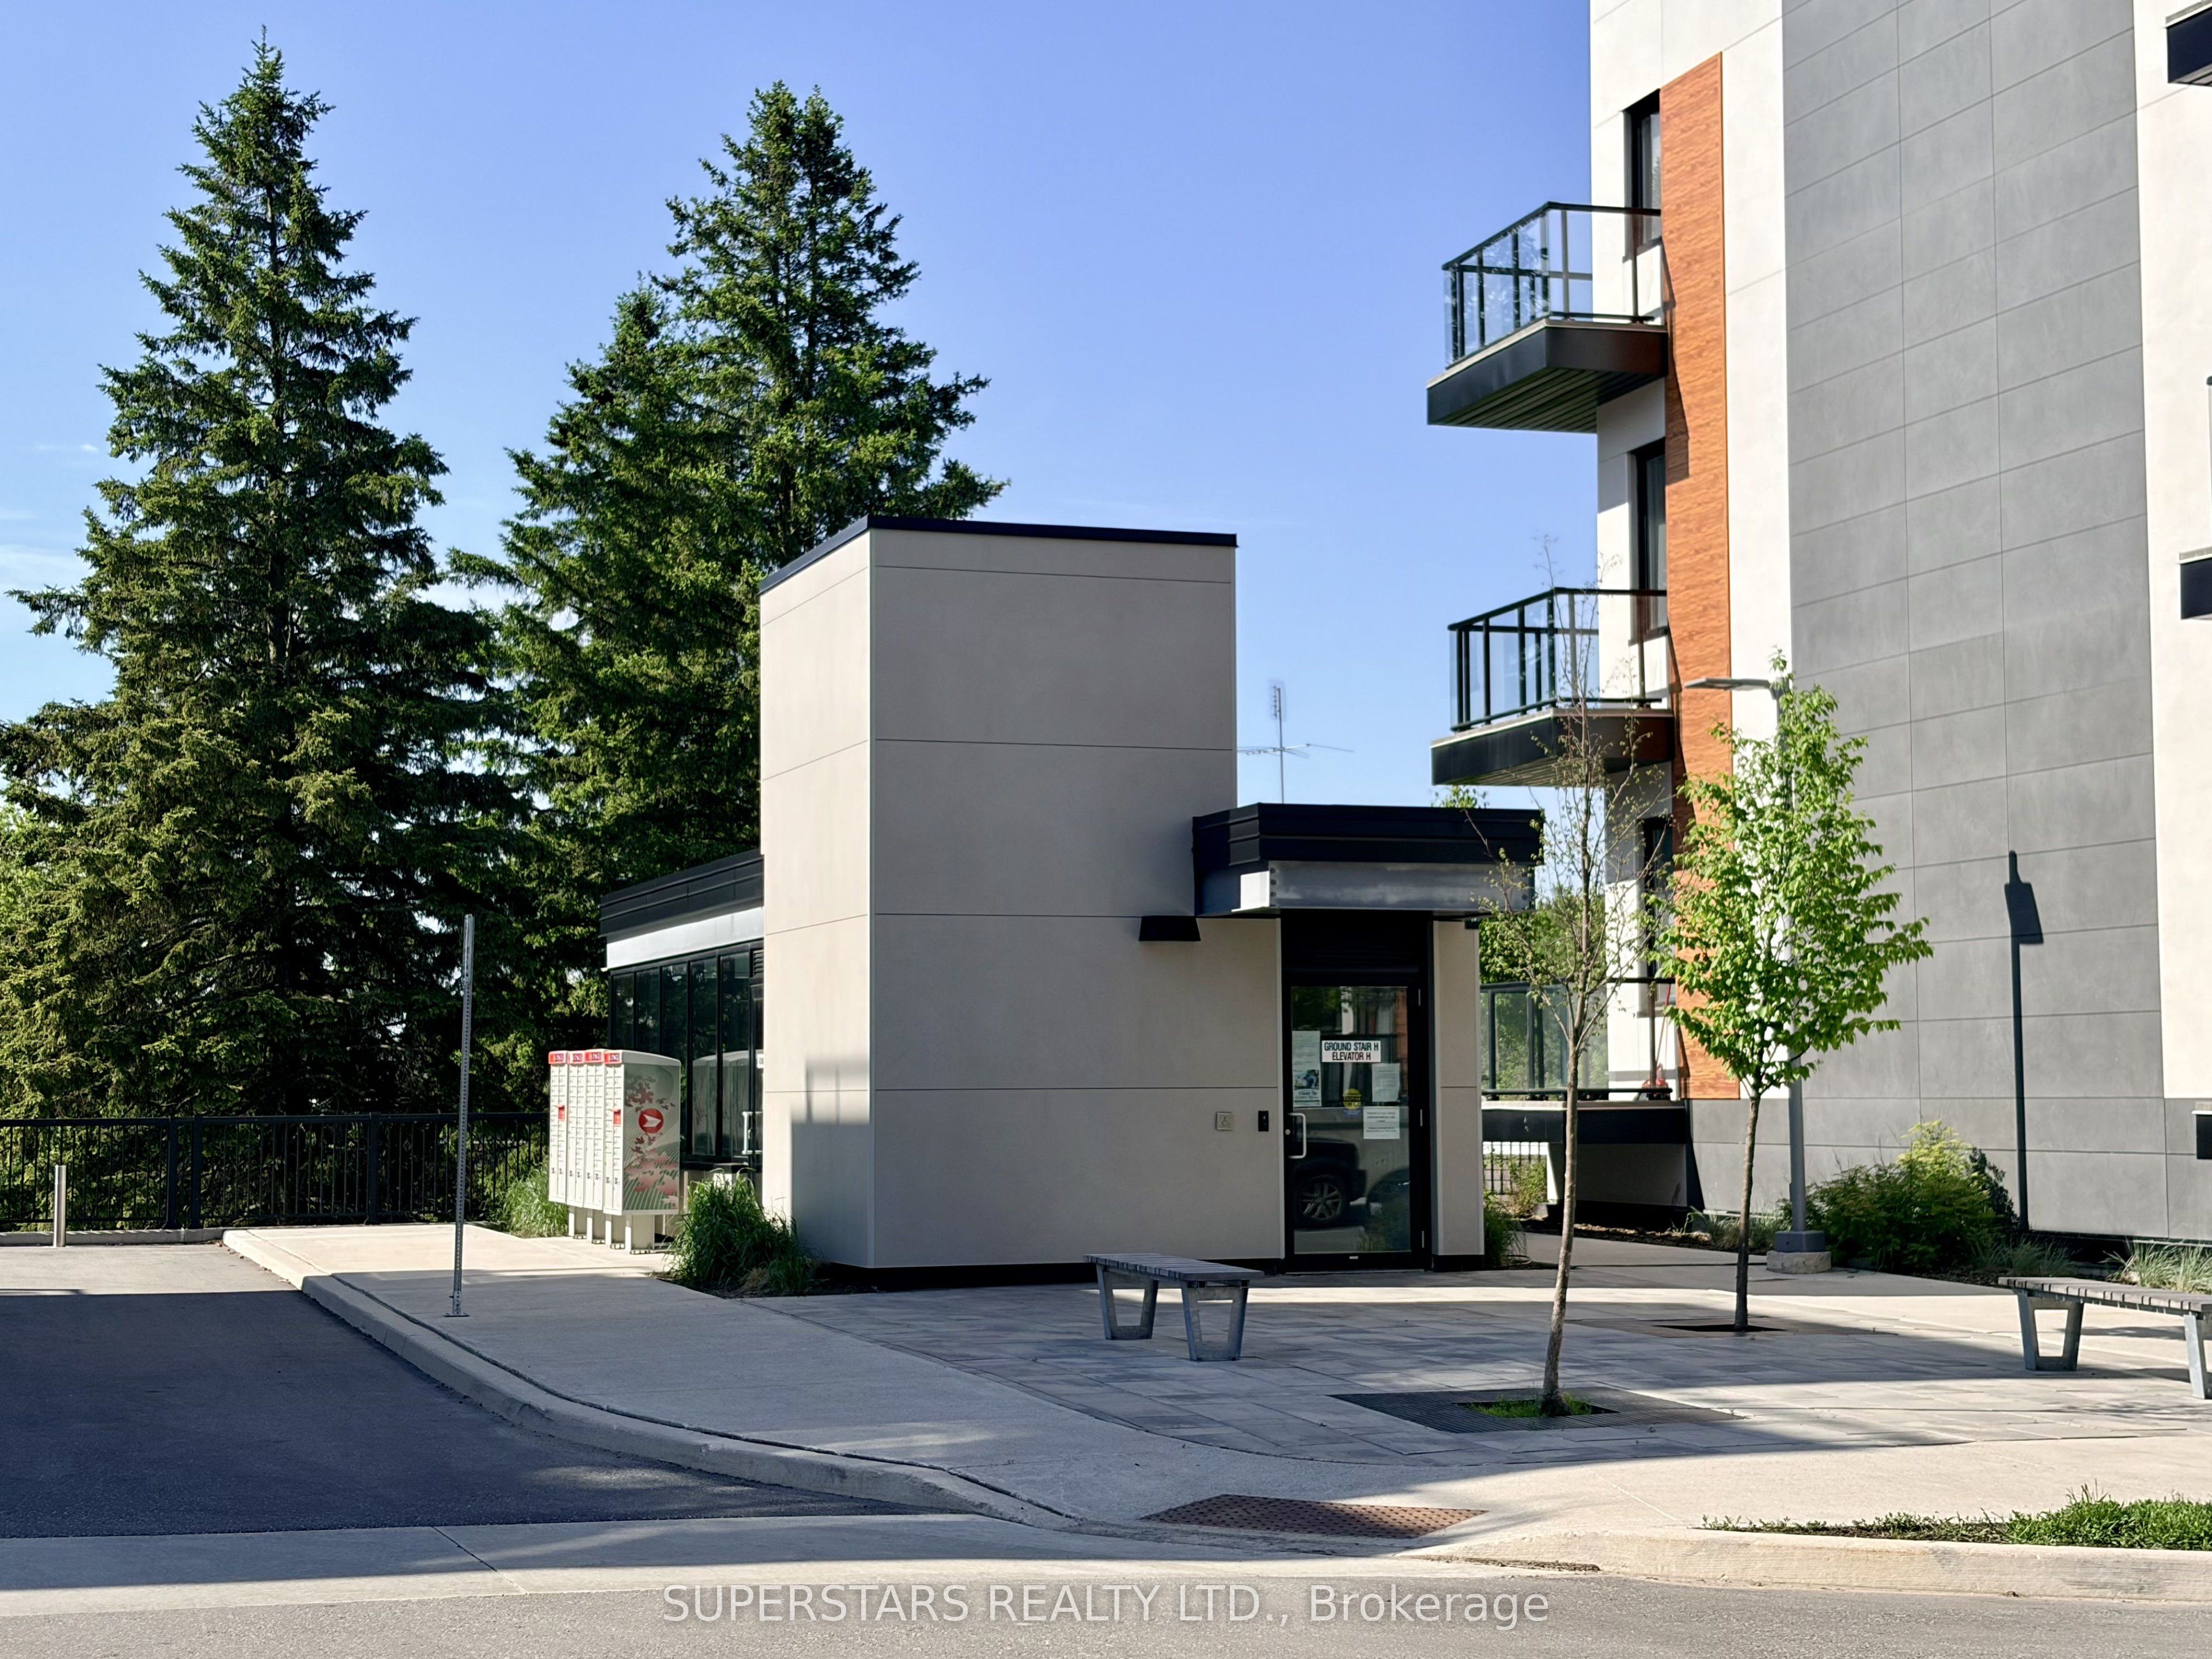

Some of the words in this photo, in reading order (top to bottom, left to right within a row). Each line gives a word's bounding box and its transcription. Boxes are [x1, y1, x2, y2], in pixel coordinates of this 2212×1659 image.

[1324, 1042, 1351, 1051] GROUND
[1354, 1042, 1372, 1051] STAIR
[1374, 1042, 1378, 1051] H
[1332, 1052, 1363, 1060] ELEVATOR
[1366, 1052, 1371, 1060] H
